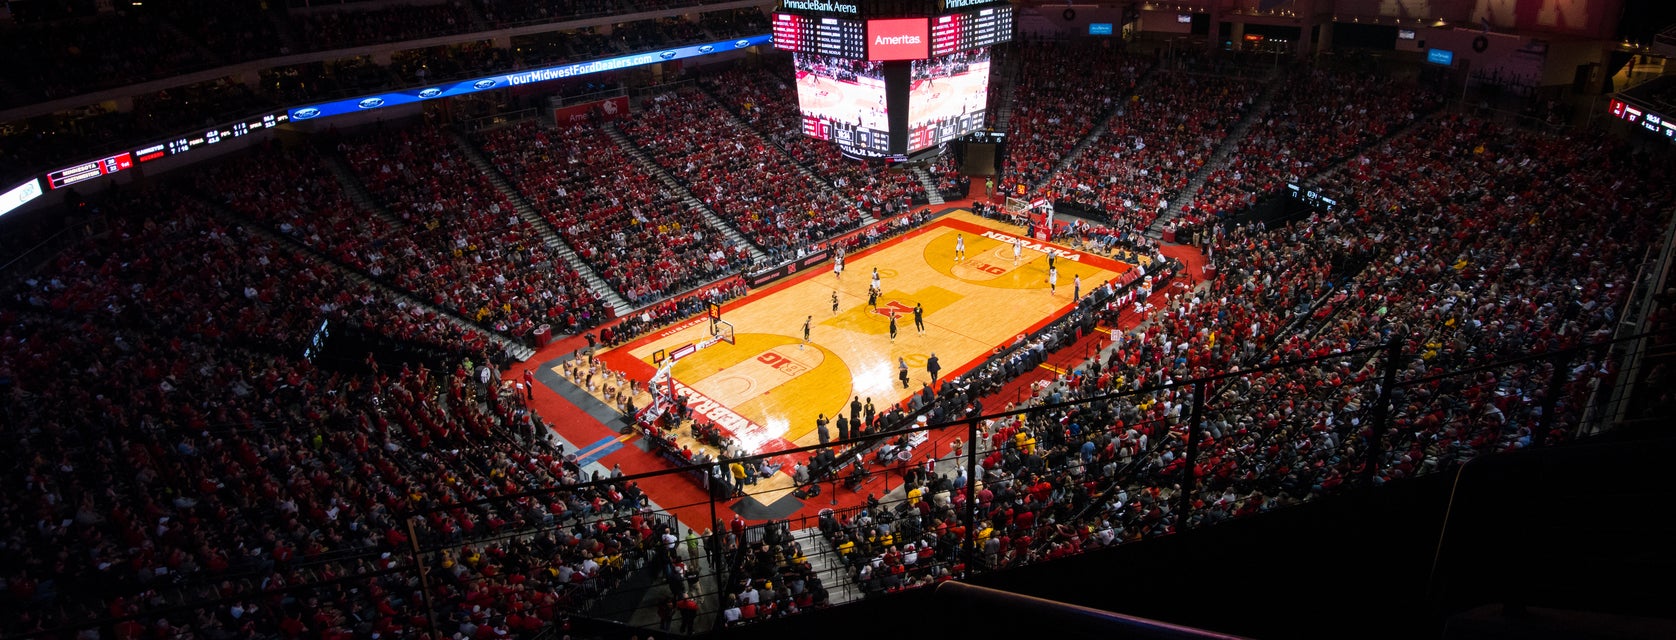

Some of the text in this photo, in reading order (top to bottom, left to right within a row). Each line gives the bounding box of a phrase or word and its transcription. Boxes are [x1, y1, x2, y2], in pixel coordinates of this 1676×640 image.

[834, 2, 857, 14] Arena
[506, 54, 652, 86] YourMidwestFordDealers.com
[981, 231, 1080, 262] NEBRASKA
